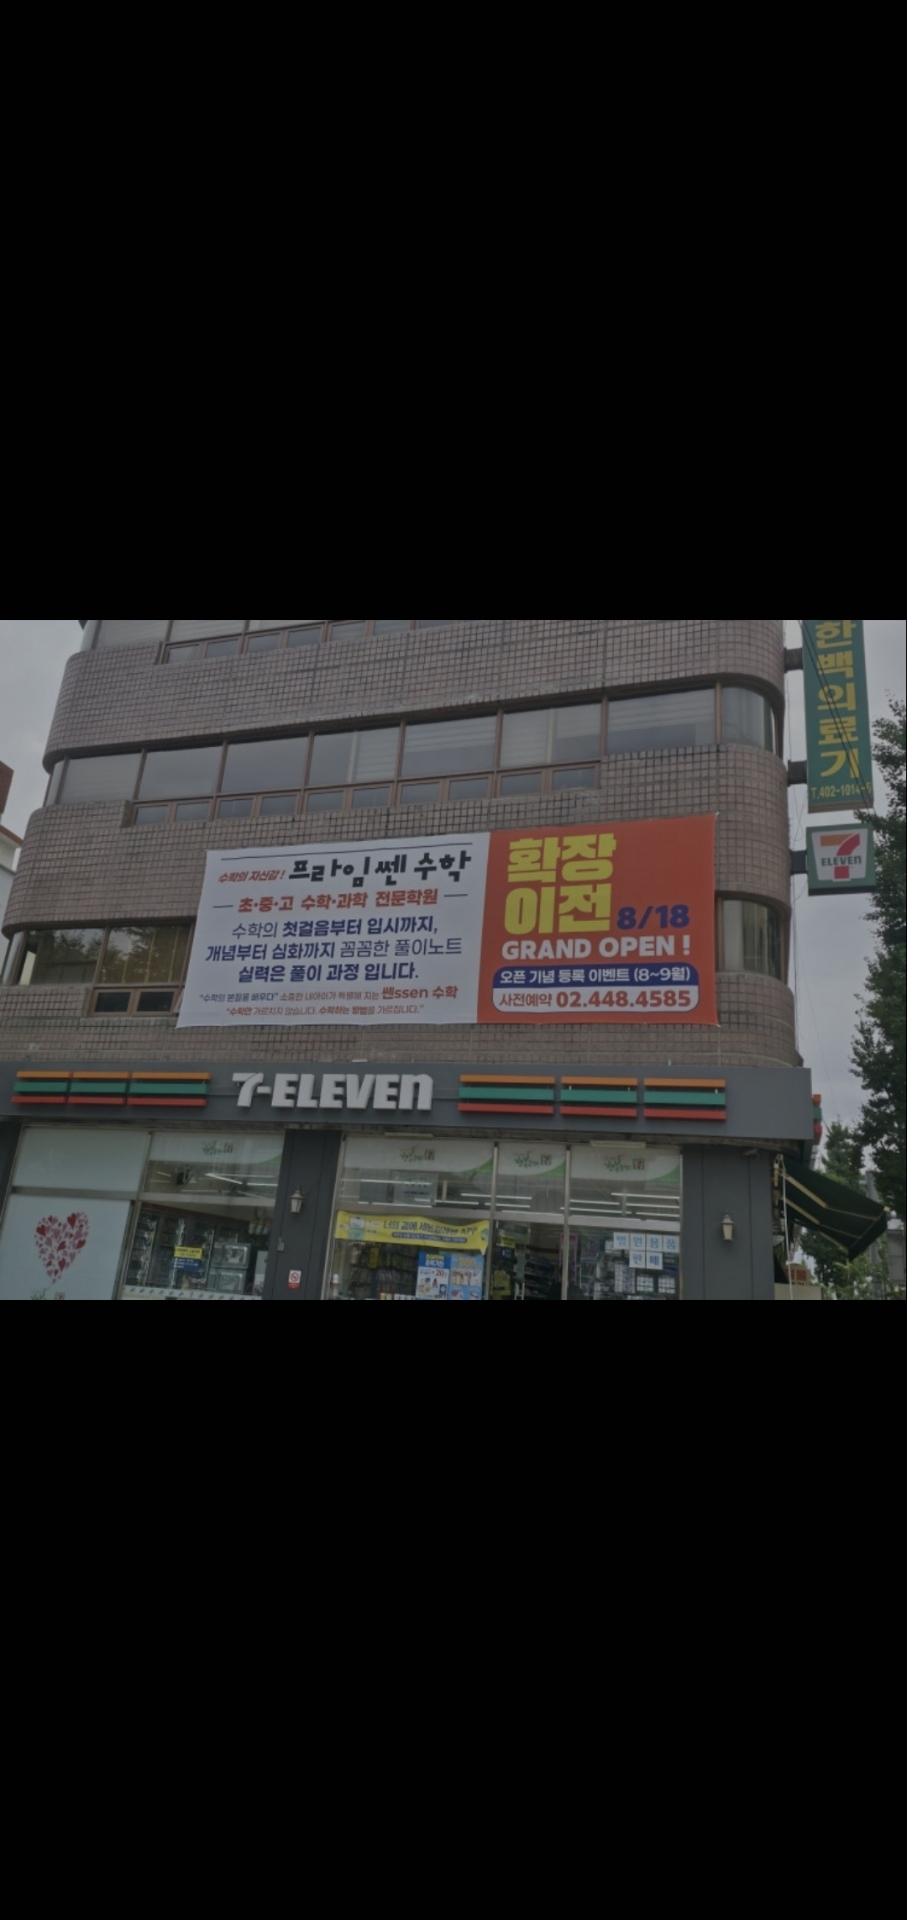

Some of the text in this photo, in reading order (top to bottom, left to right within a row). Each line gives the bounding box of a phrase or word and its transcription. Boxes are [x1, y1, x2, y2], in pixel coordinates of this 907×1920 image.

[815, 620, 859, 778] 한백의료기
[508, 833, 616, 883] 확장
[218, 871, 247, 884] 수학의
[375, 889, 438, 908] 전문학원
[504, 883, 612, 935] 이전
[232, 916, 437, 939] 수학의 첫걸음부터 입시까지,
[616, 904, 690, 930] 8/18
[205, 938, 462, 962] 개념부터 심화까지 꼼꼼한 풀이노트
[502, 938, 592, 960] GRAND
[599, 935, 675, 958] OPEN
[238, 962, 419, 983] 실력은 풀이 과정 입니다.
[500, 967, 690, 984] 오픈 기념 등록 이벤트 (8~9월)
[432, 985, 458, 998] 수학
[499, 990, 691, 1008] 사전예약 02.448.4585
